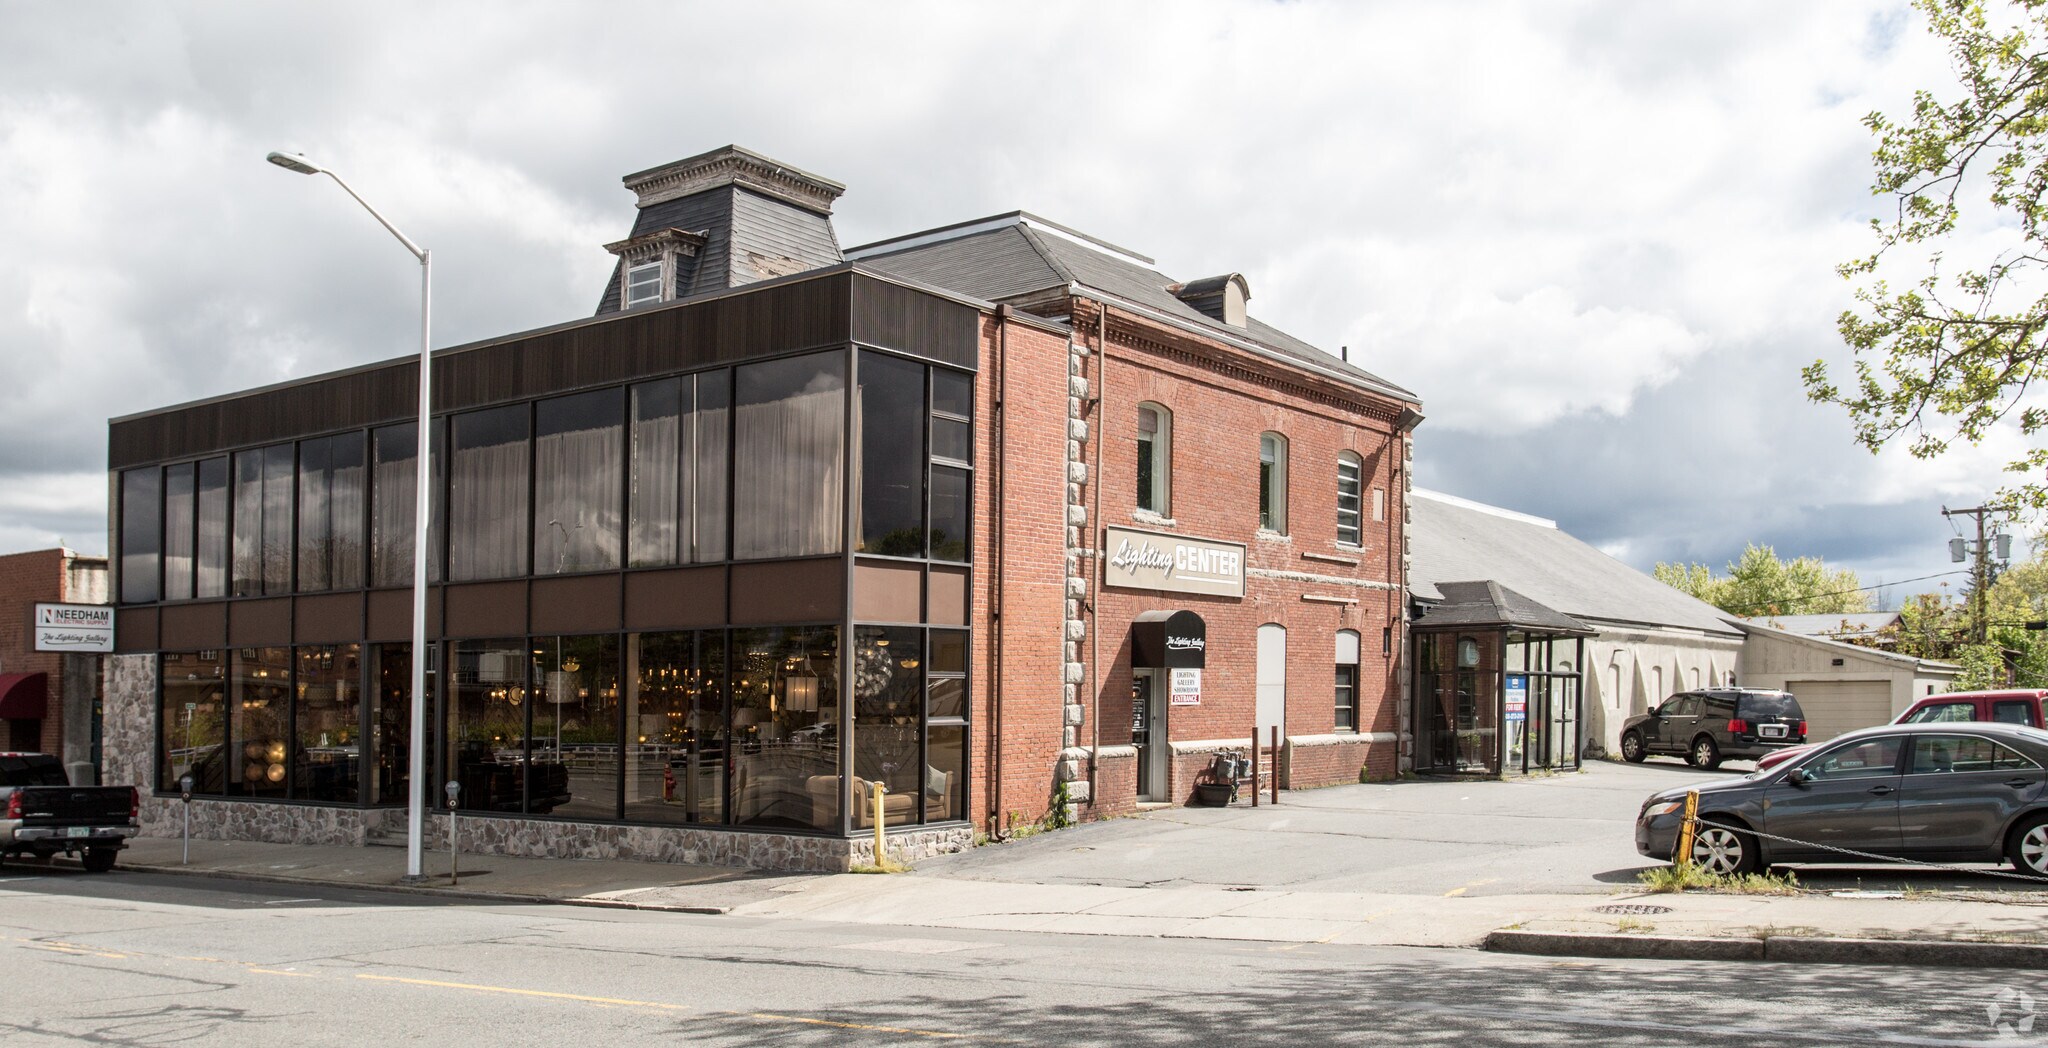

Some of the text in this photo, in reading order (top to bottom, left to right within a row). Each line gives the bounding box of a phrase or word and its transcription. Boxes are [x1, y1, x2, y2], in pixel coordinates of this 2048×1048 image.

[1111, 537, 1239, 579] Lighting CENTER
[56, 609, 108, 620] NEEDHAM
[41, 633, 108, 643] The Lighting Gallery
[1166, 635, 1175, 646] The
[1174, 636, 1191, 647] Lighting
[1176, 671, 1196, 679] LIGHTING
